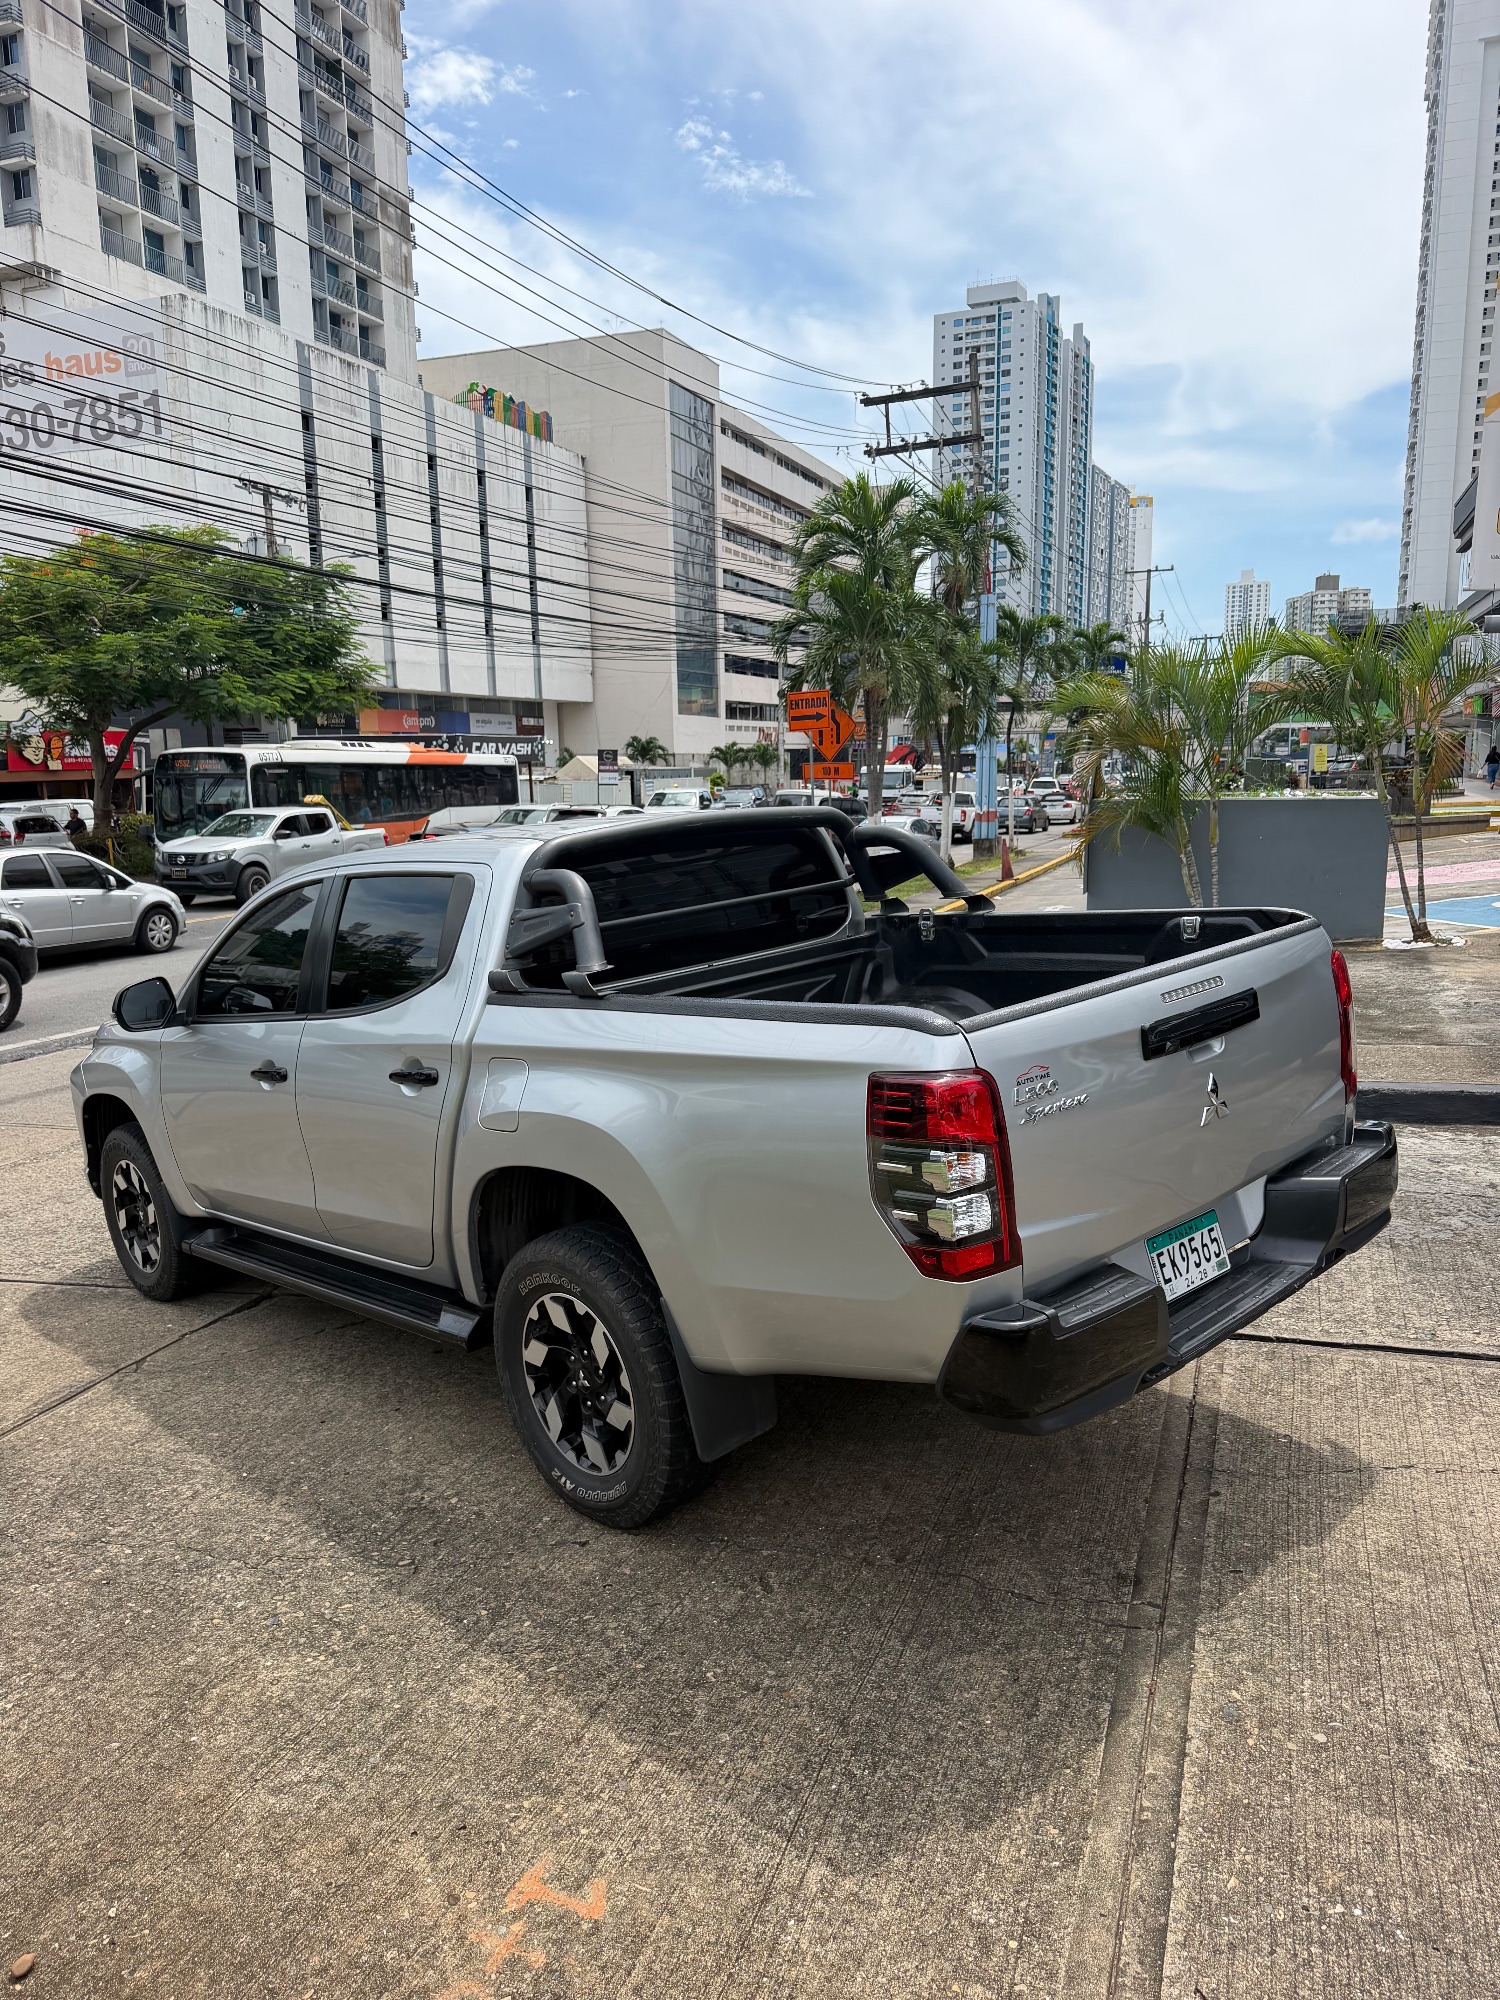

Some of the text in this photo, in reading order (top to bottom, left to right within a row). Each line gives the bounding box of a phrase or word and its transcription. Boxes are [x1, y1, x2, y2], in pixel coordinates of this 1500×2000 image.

[0, 350, 121, 388] es haus
[0, 389, 163, 451] 30-7851
[790, 697, 827, 710] ENTRADA
[472, 742, 531, 755] CAR WASH
[833, 767, 840, 776] M
[1016, 1071, 1051, 1086] AUTO TIME
[1013, 1079, 1059, 1106] L200
[1156, 1227, 1222, 1285] EK9565
[551, 1467, 628, 1502] Dynapro AT2
